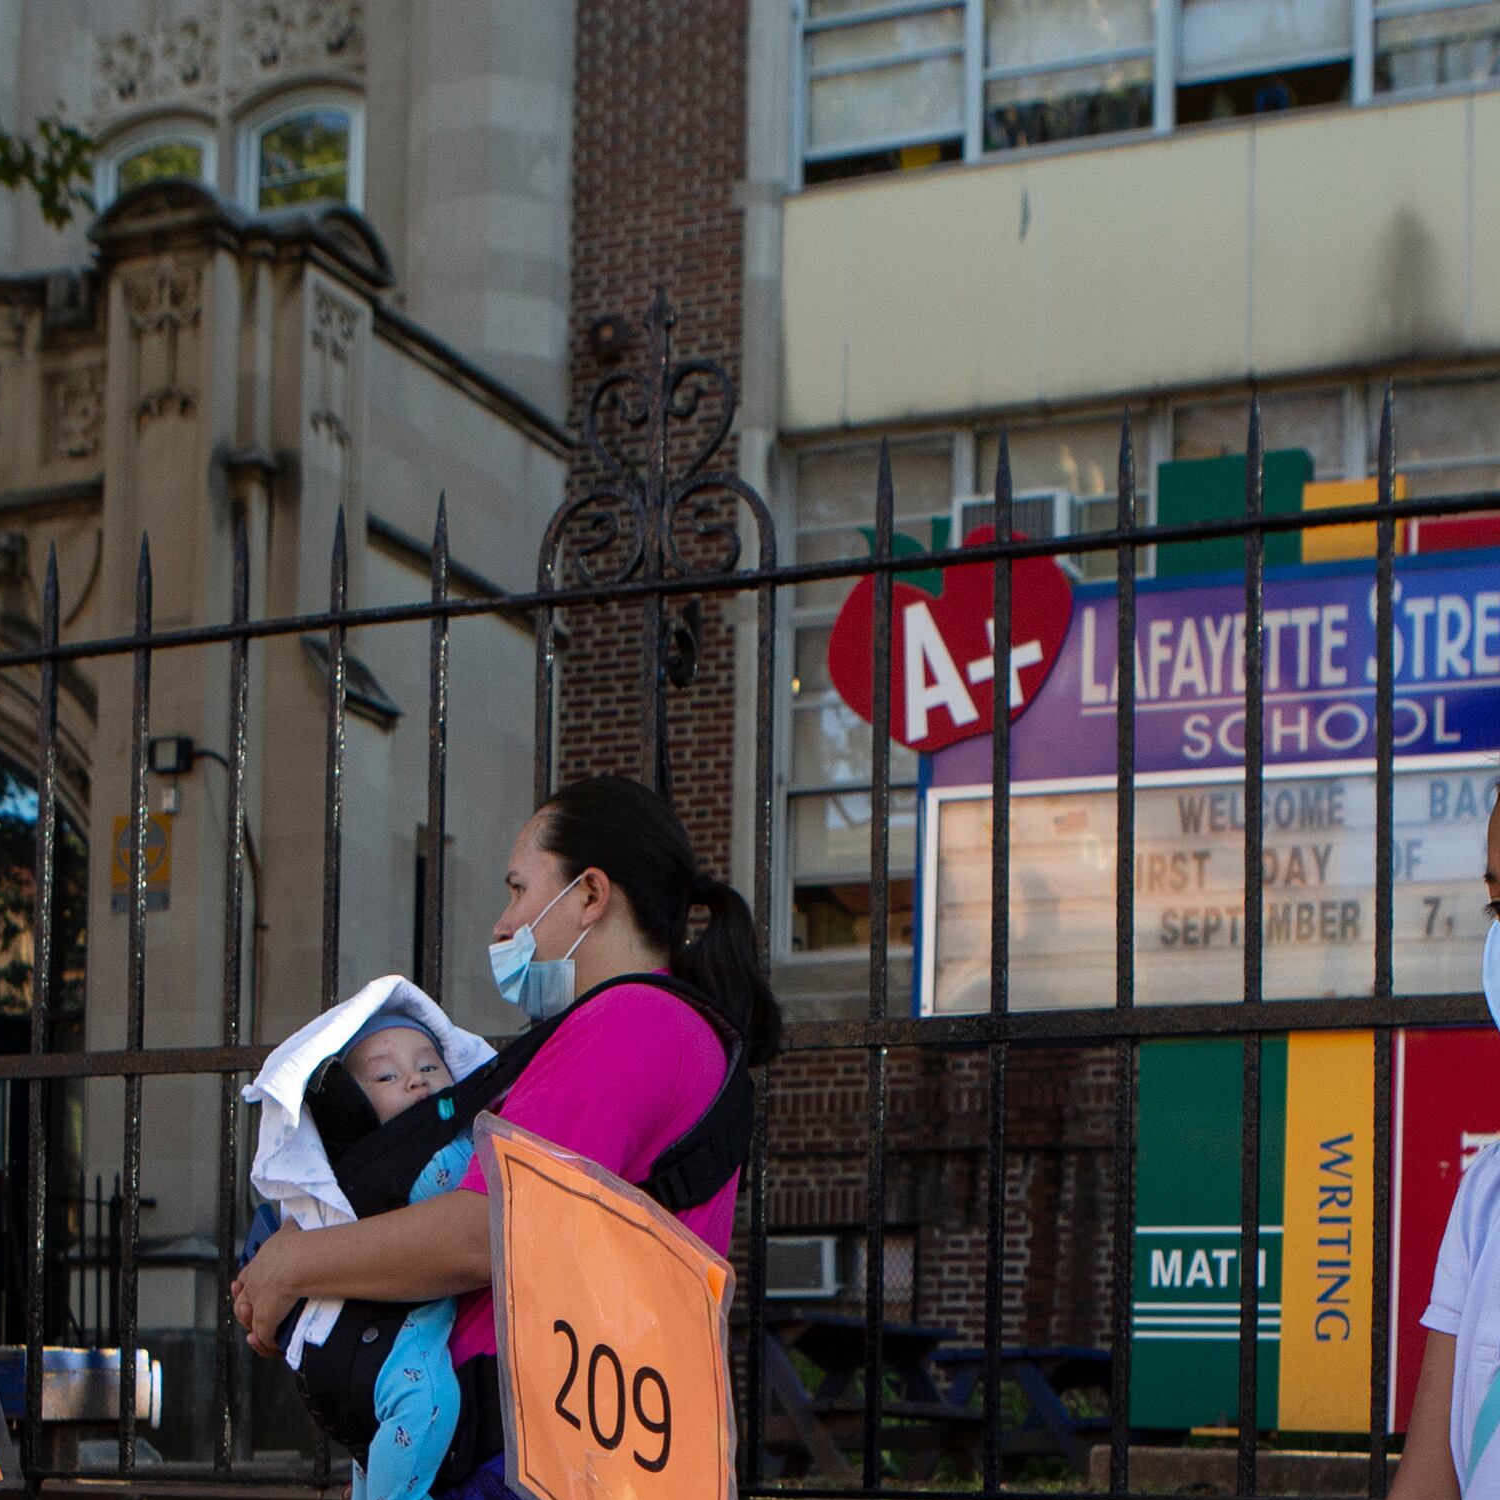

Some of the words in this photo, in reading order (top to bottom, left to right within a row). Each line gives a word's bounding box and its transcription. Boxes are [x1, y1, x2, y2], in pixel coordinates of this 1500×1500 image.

[904, 600, 1043, 742] A+
[1183, 698, 1461, 759] SCHOOL
[1178, 783, 1346, 833] WELOME
[1429, 776, 1500, 820] BAC
[1135, 848, 1211, 893] IRST
[1160, 900, 1361, 946] SEPTMBER
[1315, 1133, 1355, 1343] WRITING
[553, 1319, 672, 1473] 209
